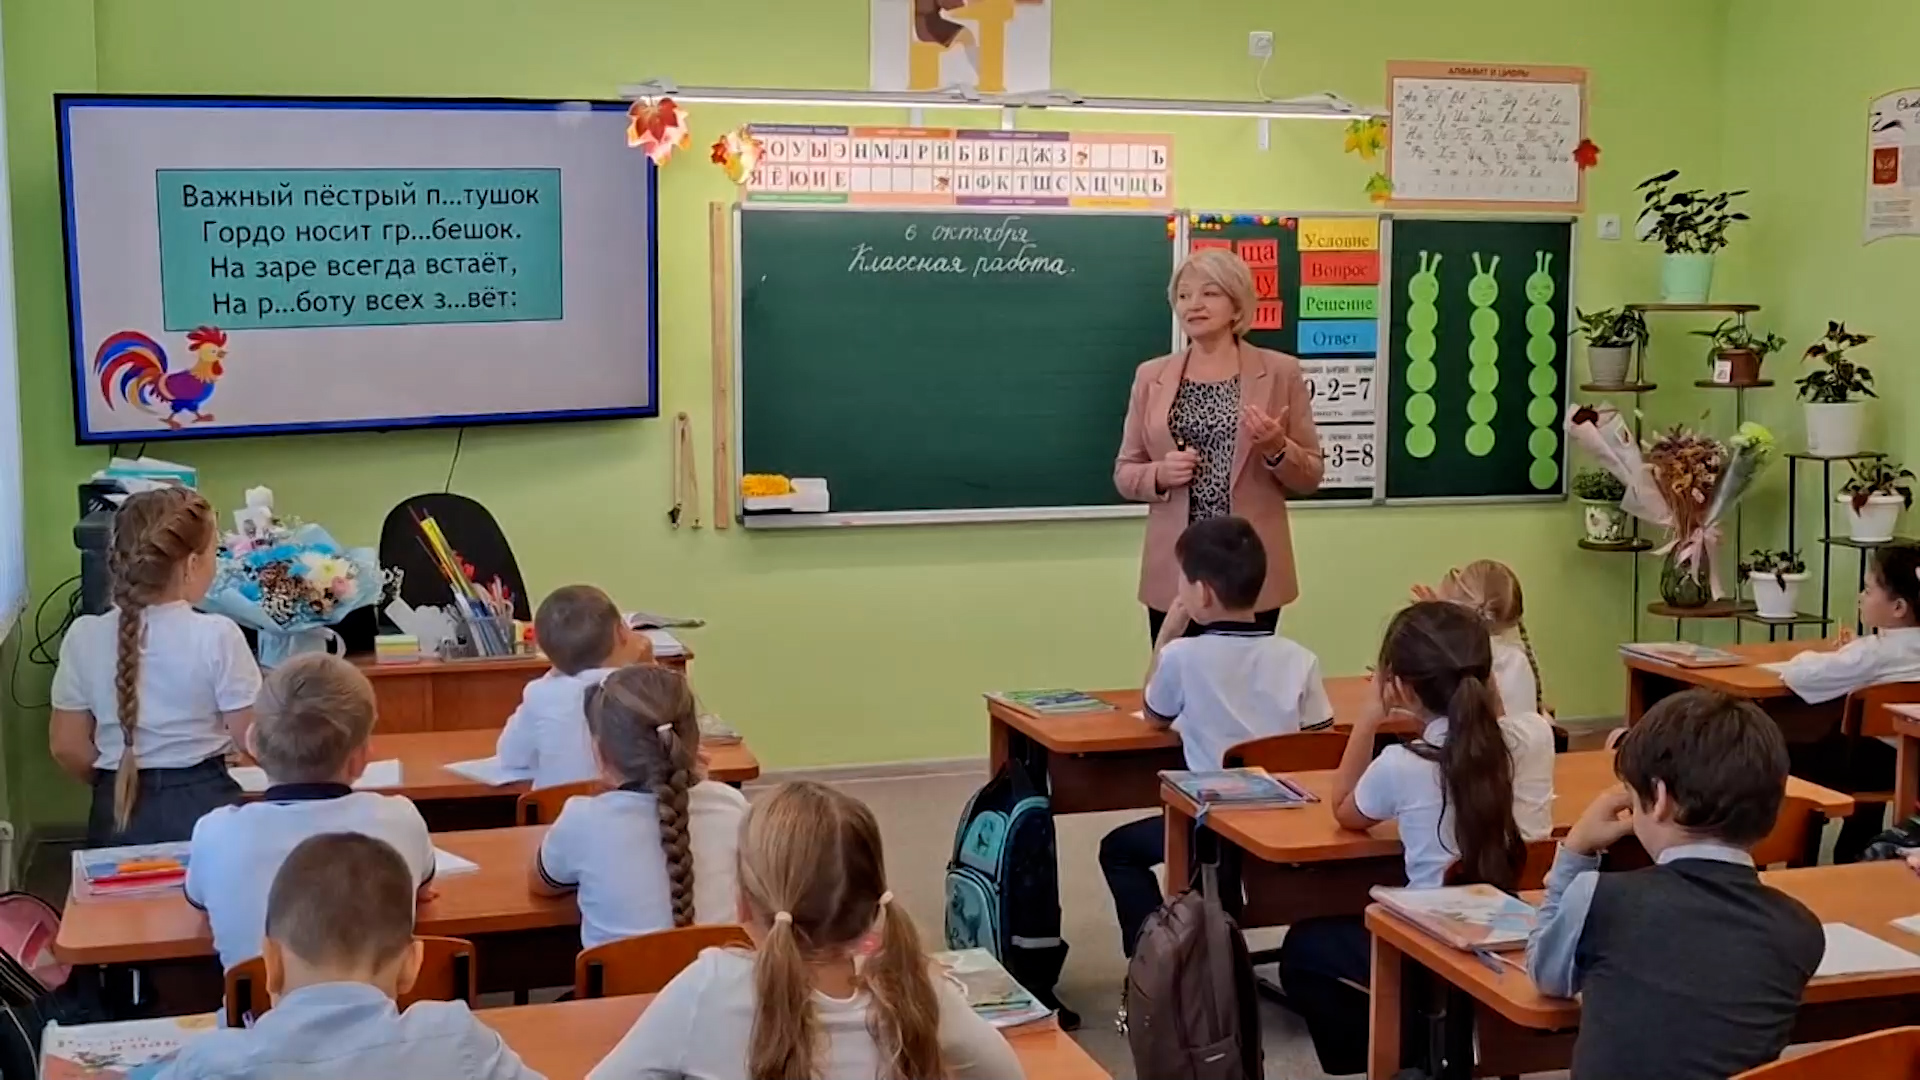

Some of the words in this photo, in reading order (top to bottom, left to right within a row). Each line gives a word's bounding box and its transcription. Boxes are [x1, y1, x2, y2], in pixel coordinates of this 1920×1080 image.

[770, 141, 785, 156] О
[793, 141, 807, 157] У
[811, 143, 827, 158] Ы
[833, 144, 847, 159] Э
[854, 145, 867, 159] Н
[874, 145, 890, 159] М
[894, 145, 909, 160] Л
[918, 146, 929, 160] Р
[958, 146, 969, 161] Б
[978, 147, 989, 161] В
[998, 147, 1009, 161] Г
[1016, 148, 1030, 165] Д
[1034, 148, 1051, 163] Ж
[1056, 149, 1066, 163] З
[1152, 150, 1164, 165] Ъ
[750, 171, 763, 186] Я
[790, 172, 808, 187] Ю
[813, 172, 826, 187] И
[836, 172, 847, 187] Е
[957, 175, 970, 190] П
[976, 175, 991, 190] Ф
[997, 175, 1009, 190] К
[1016, 176, 1028, 190] Т
[1056, 176, 1068, 191] С
[1075, 176, 1087, 191] Х
[1114, 177, 1124, 191] Ч
[1153, 177, 1163, 192] Ь
[183, 183, 292, 207] Важный
[305, 182, 415, 211] пёстрый
[428, 189, 539, 209] п...тушок
[204, 221, 284, 248] Гордо
[297, 225, 371, 241] носит
[384, 218, 520, 245] гр...бешок.
[905, 224, 917, 241] 6
[932, 216, 1037, 252] октября
[1304, 234, 1370, 248] Условие
[847, 242, 969, 273] Классная
[973, 243, 1076, 277] работа.
[1242, 245, 1275, 263] ща
[212, 256, 244, 278] На
[256, 261, 316, 282] заре
[328, 259, 415, 279] всегда
[427, 252, 516, 275] встаёт,
[1312, 262, 1368, 280] Вопрос
[213, 293, 246, 314] На
[259, 291, 355, 319] р...боту
[367, 294, 423, 310] всех
[435, 287, 516, 309] з...вёт:
[1306, 296, 1373, 311] Решение
[1313, 331, 1358, 346] Ответ
